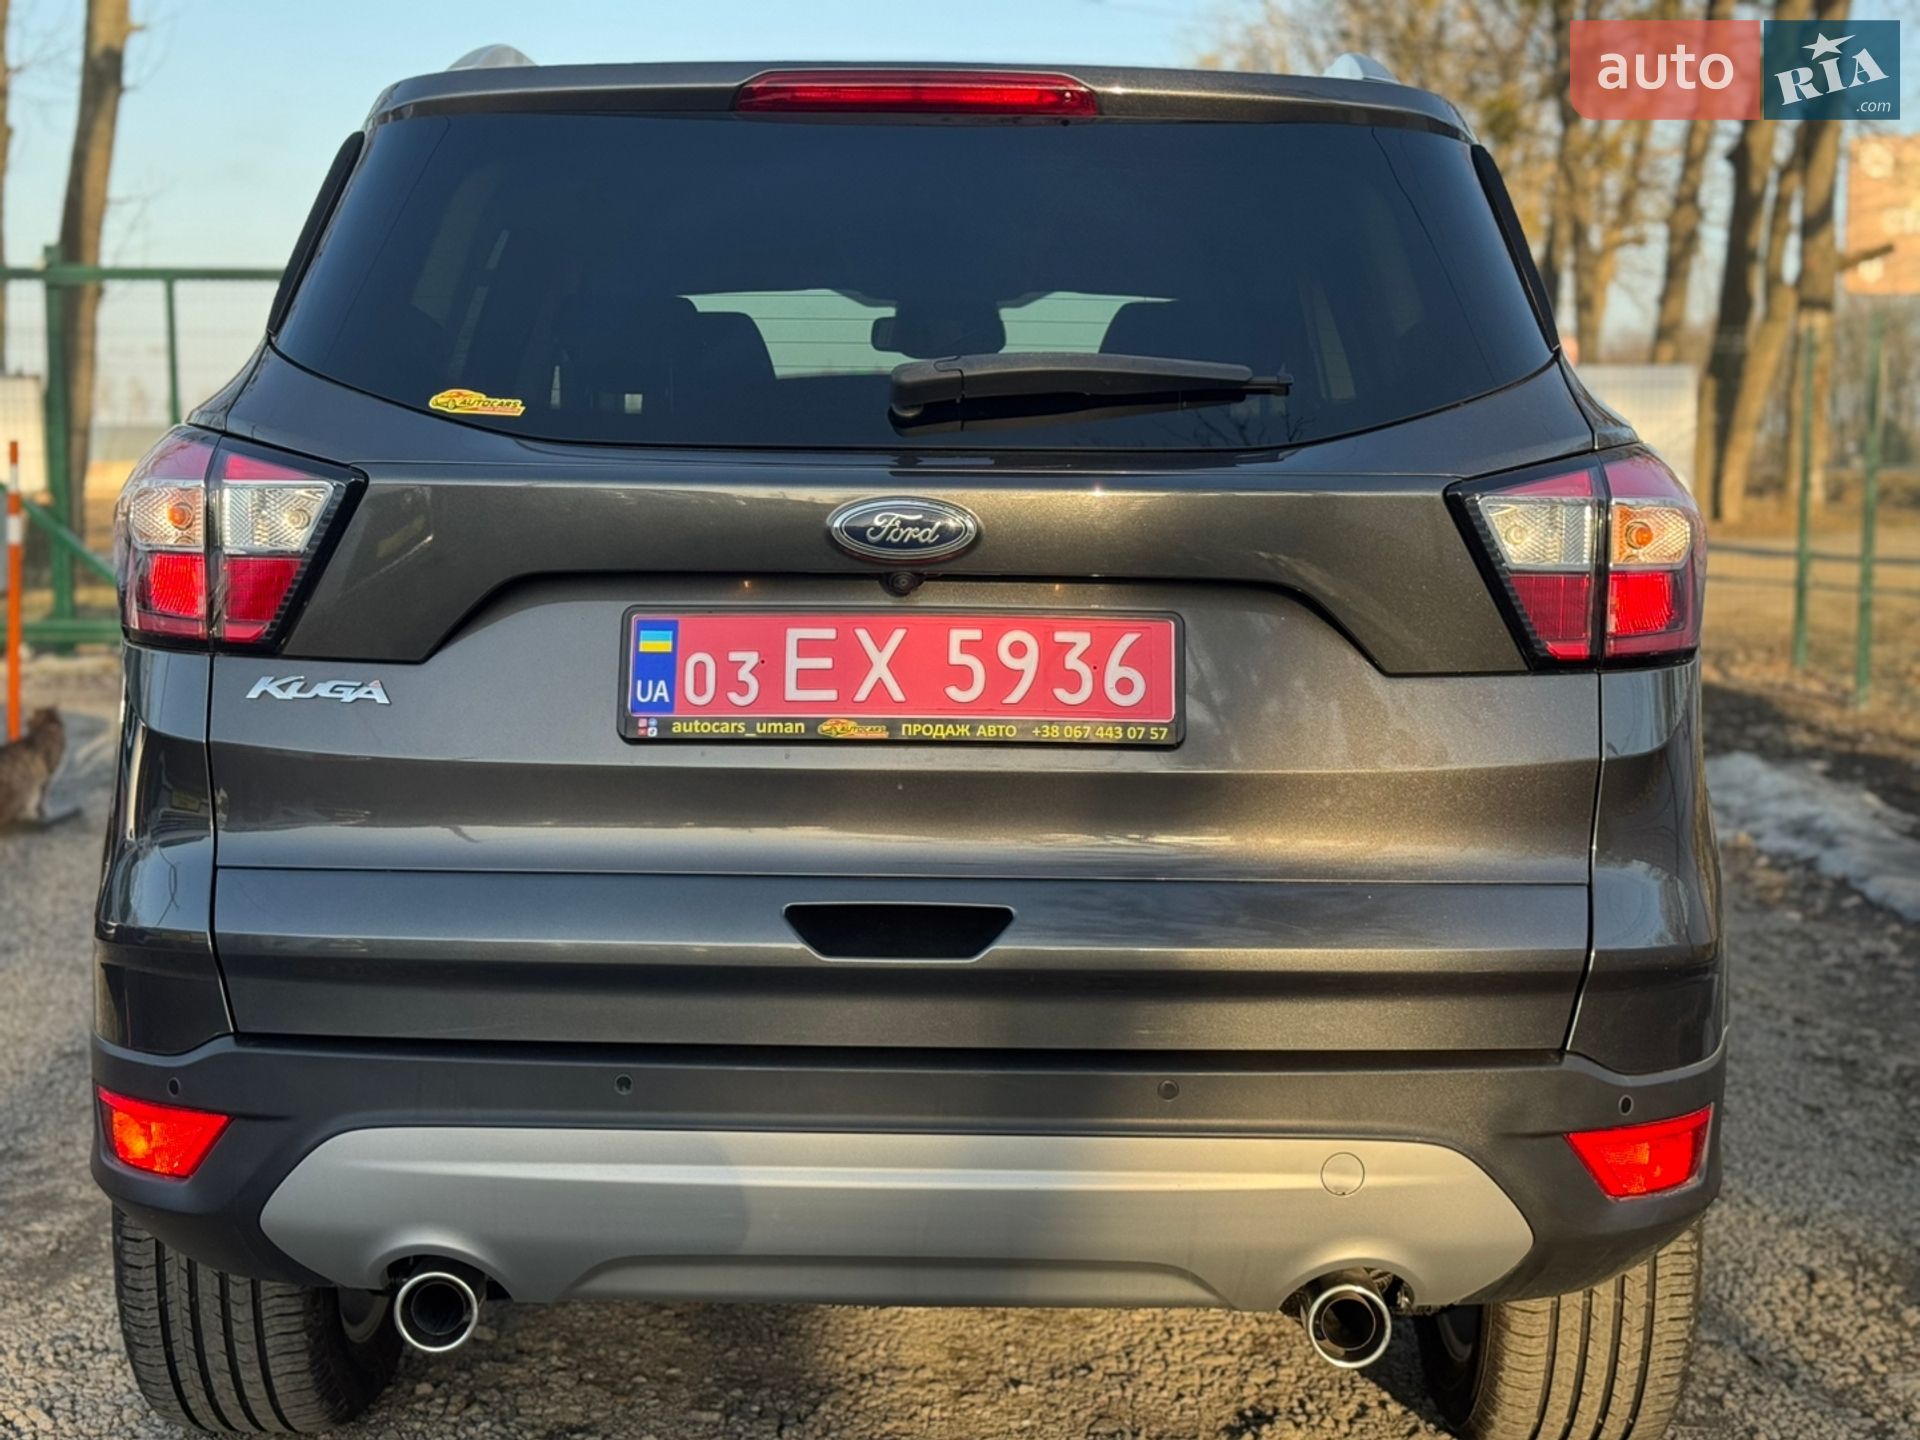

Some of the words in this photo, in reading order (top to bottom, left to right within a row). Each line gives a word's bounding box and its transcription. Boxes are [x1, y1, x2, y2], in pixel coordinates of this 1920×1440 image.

[459, 400, 520, 408] AUTOCARS
[866, 512, 941, 543] Ford
[684, 651, 761, 707] 03
[784, 627, 907, 702] EX
[944, 628, 1147, 708] 5936
[246, 676, 390, 704] KUGA
[636, 680, 670, 703] UA
[672, 719, 805, 736] autocars_uman
[901, 723, 970, 738] ПРОДАЖ
[976, 724, 1017, 737] АВТО
[1032, 726, 1059, 738] +38
[1064, 726, 1090, 739] 067
[1095, 726, 1123, 739] 443
[1127, 727, 1145, 740] 07
[1150, 728, 1168, 740] 57
